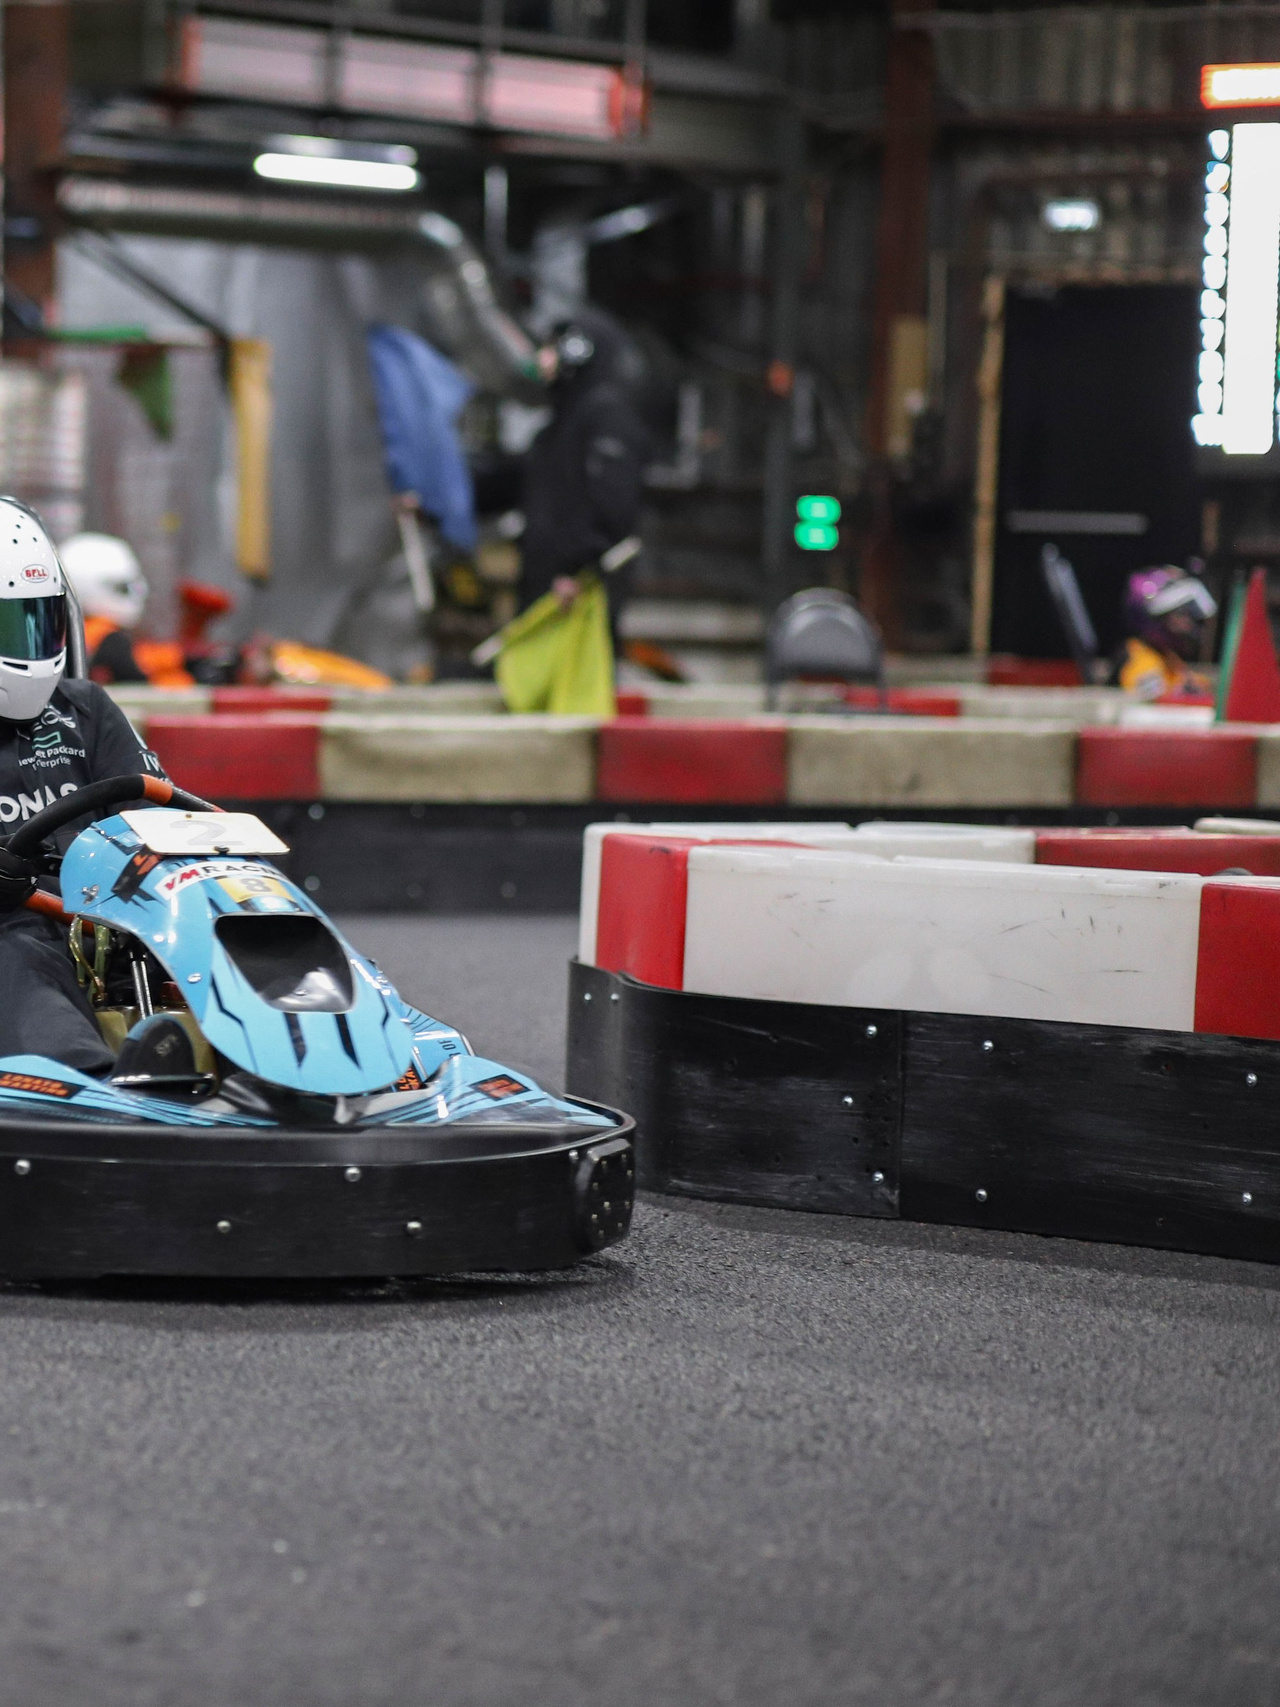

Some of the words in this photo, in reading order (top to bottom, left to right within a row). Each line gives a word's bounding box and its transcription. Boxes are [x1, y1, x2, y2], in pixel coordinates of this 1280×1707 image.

[46, 746, 86, 758] Packard
[169, 820, 245, 846] 2
[240, 878, 272, 892] 8
